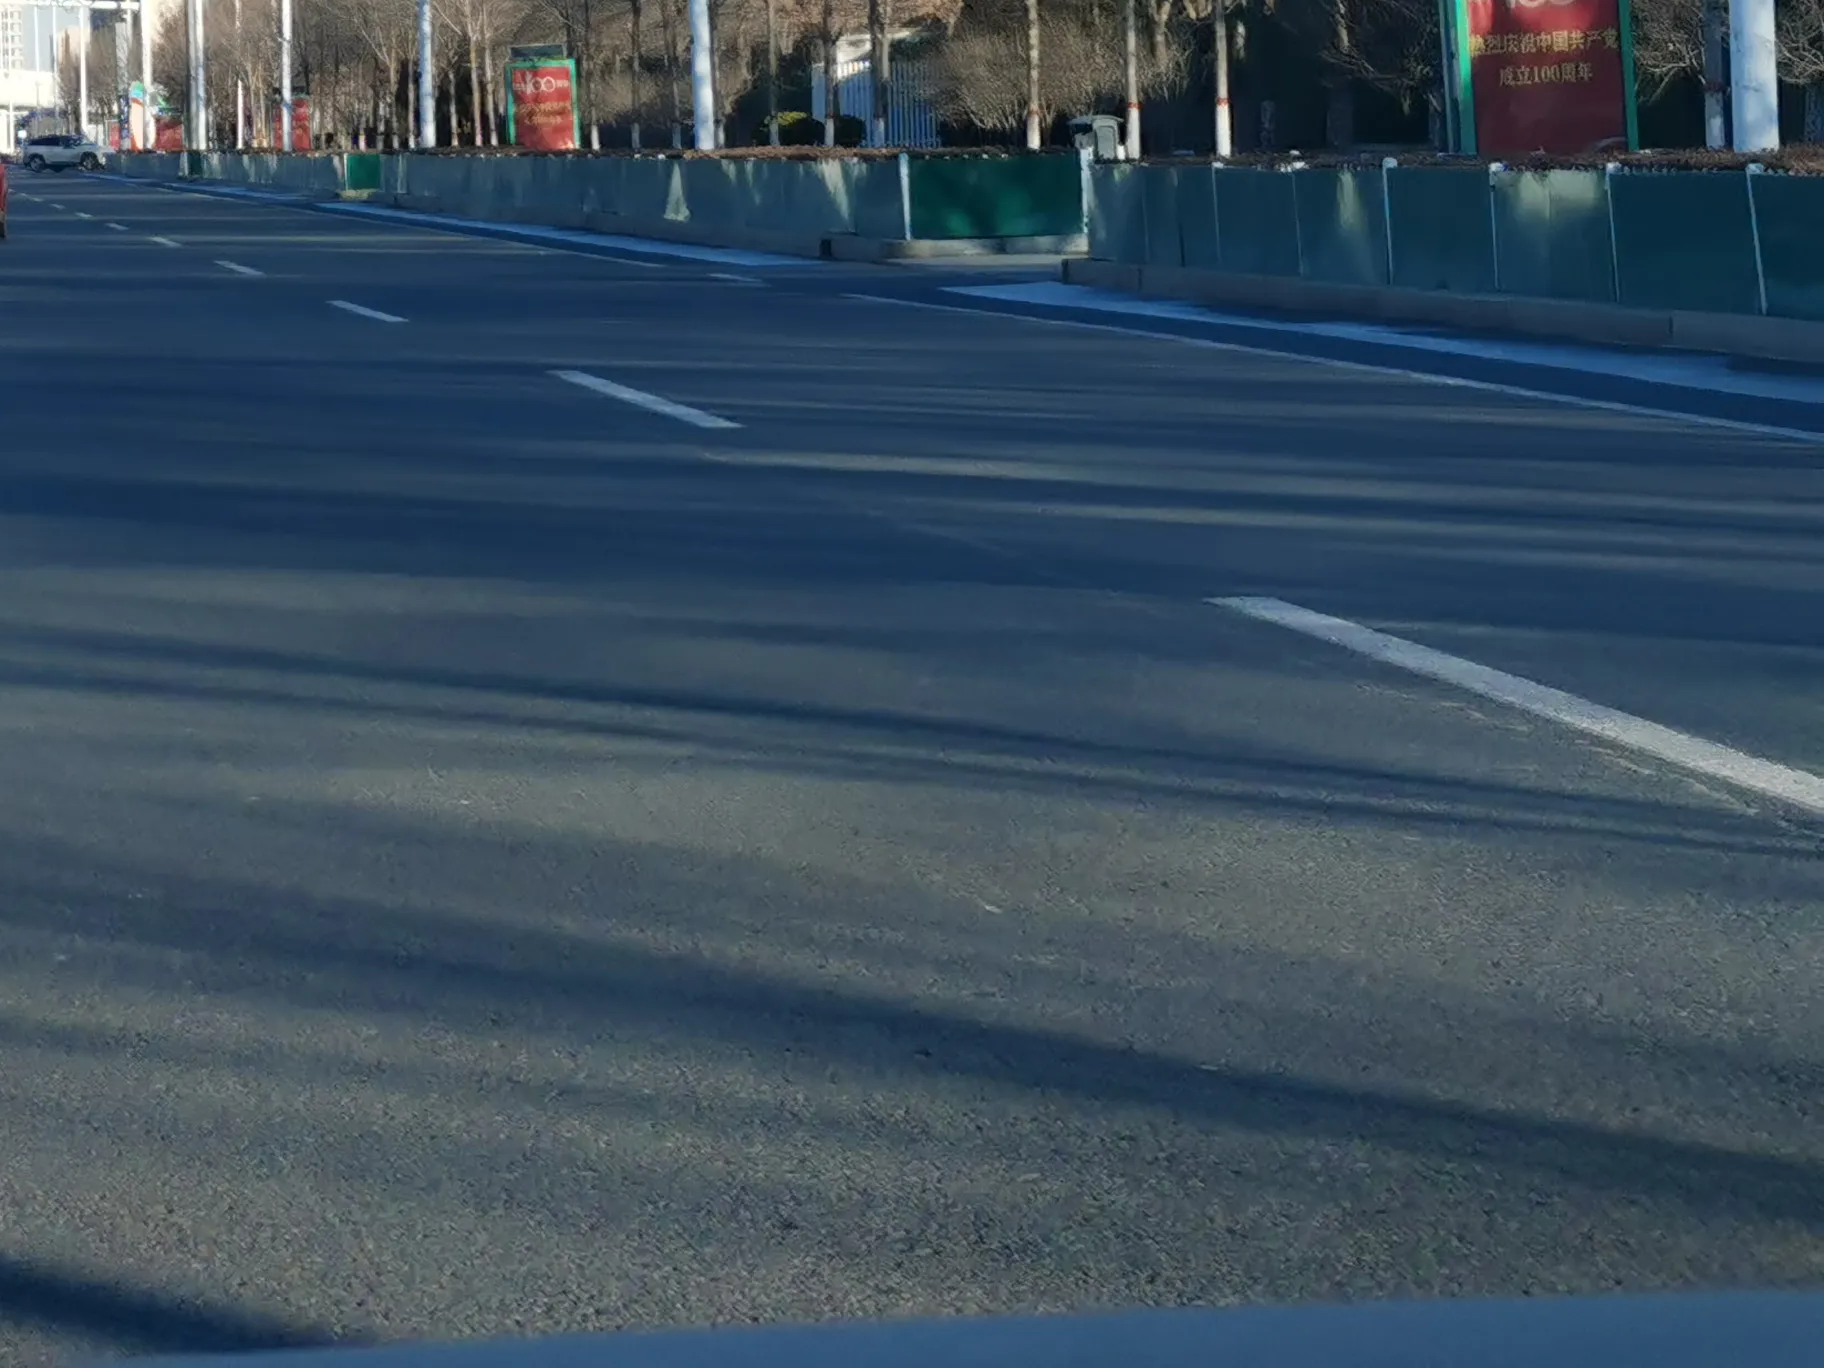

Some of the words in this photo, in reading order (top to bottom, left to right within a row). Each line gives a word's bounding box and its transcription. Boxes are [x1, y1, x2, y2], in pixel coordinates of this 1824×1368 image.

[1469, 27, 1620, 59] 热烈庆祝中国共产党
